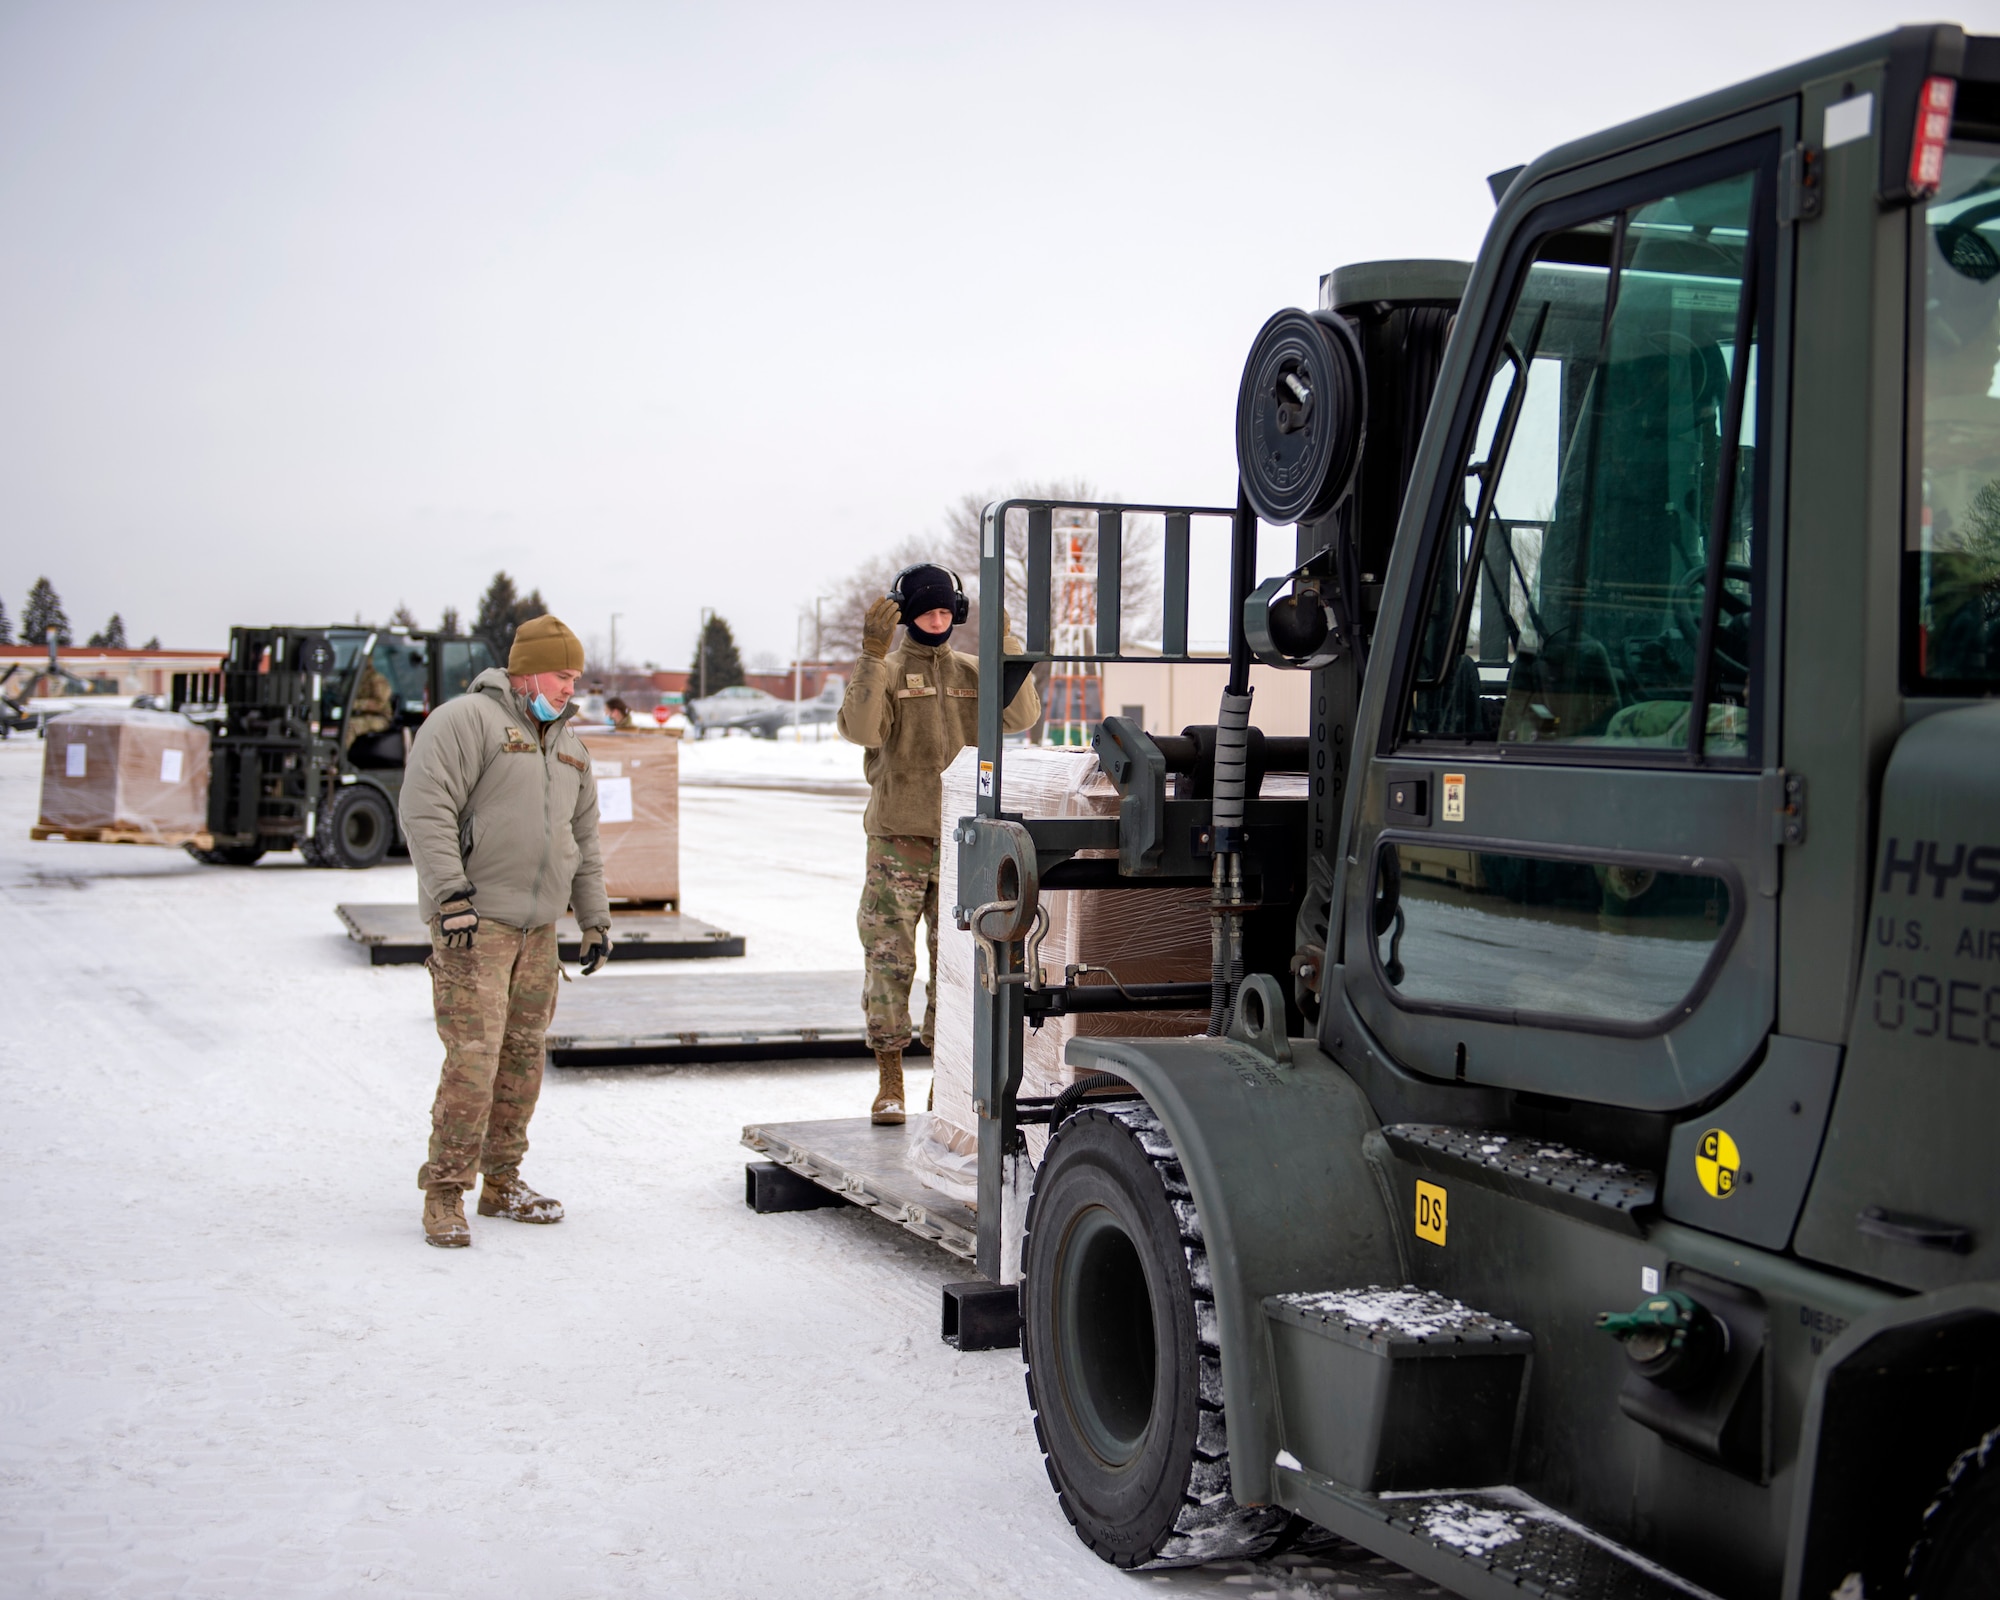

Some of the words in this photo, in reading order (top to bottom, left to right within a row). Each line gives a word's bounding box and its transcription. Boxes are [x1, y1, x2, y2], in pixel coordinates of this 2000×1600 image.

[1333, 724, 1344, 798] CAP
[1880, 837, 2000, 904] HYS
[1877, 916, 1930, 951] U.S.
[1955, 928, 2000, 960] AIR
[1249, 1061, 1285, 1086] HERE
[1705, 1136, 1717, 1156] C
[1719, 1170, 1732, 1191] G
[1420, 1193, 1442, 1231] DS
[1800, 1305, 1850, 1336] DIESE
